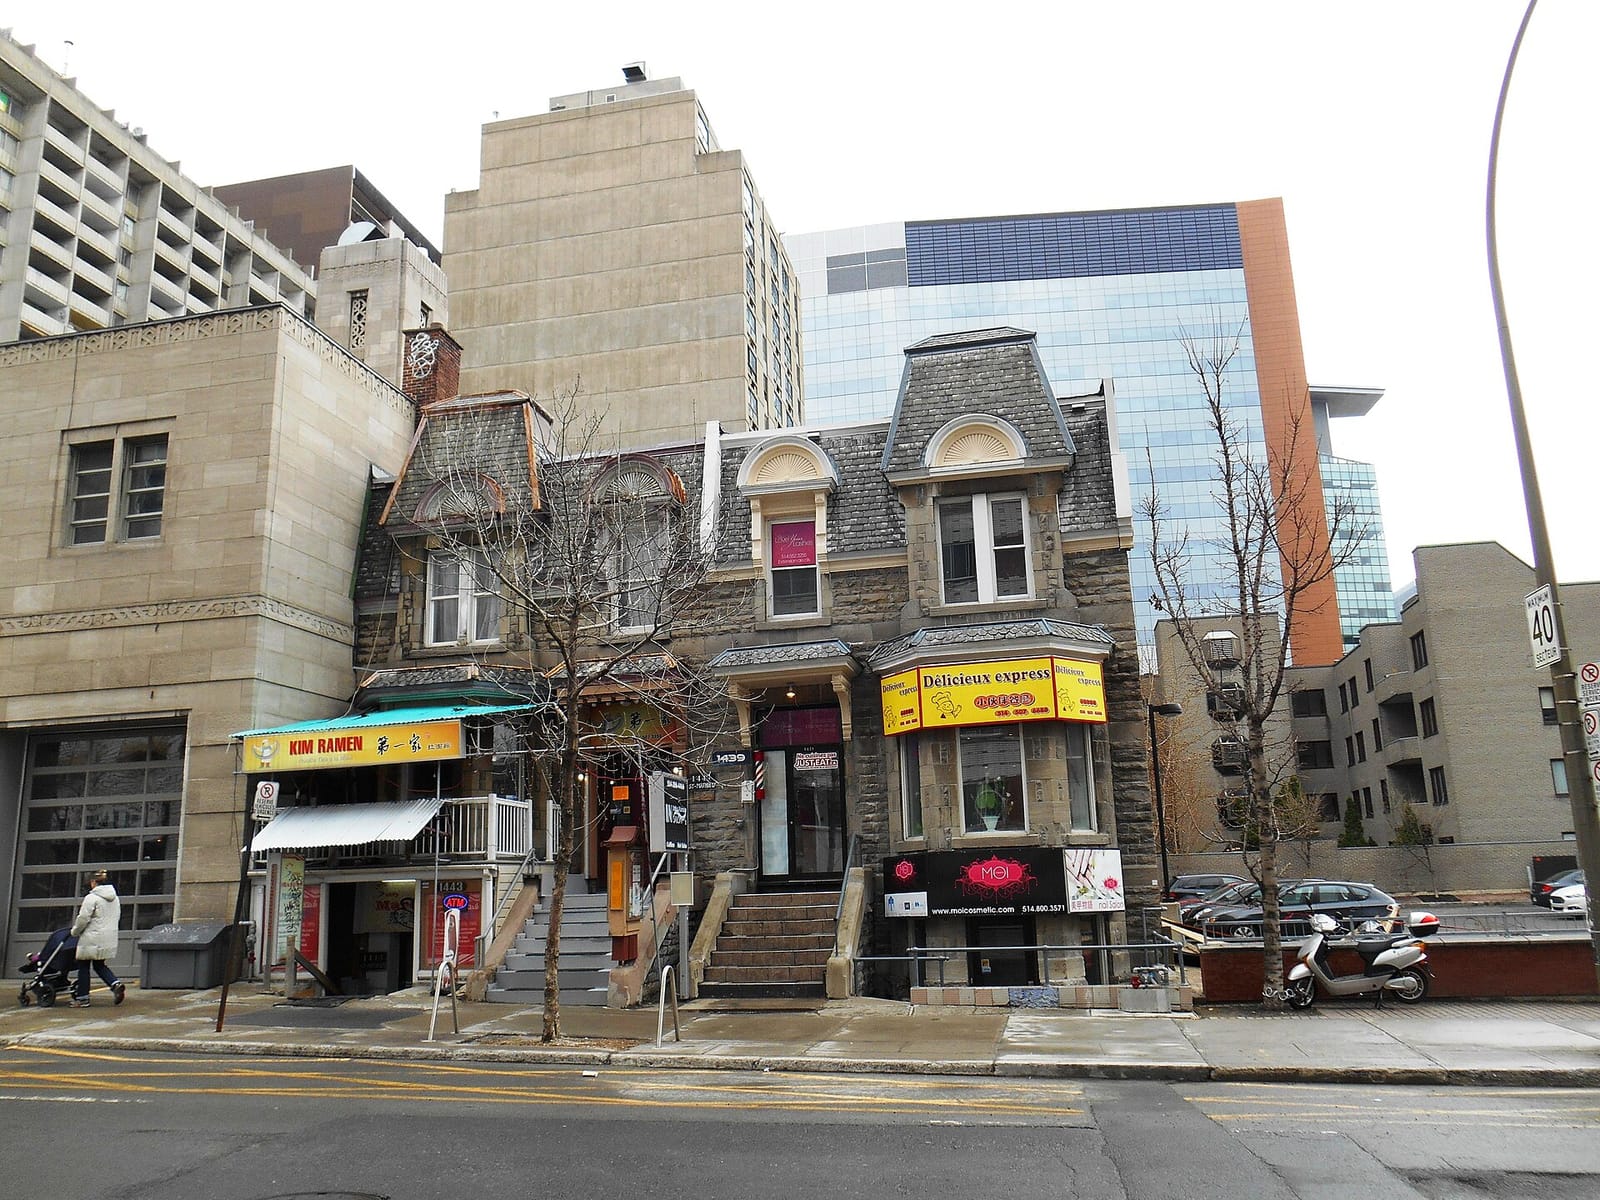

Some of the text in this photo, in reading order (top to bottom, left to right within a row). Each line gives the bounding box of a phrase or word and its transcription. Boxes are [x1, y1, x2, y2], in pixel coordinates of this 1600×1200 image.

[1527, 591, 1549, 609] MAXIMUM
[1533, 605, 1554, 646] 40
[1536, 646, 1557, 664] SECTEUR
[995, 669, 1050, 684] express
[289, 736, 363, 755] KIM RAMEN
[377, 733, 422, 756] 第一家
[716, 753, 746, 763] 1439
[982, 865, 1009, 880] MOI
[439, 882, 464, 892] 1443
[446, 898, 465, 908] ATM
[932, 906, 1015, 915] www.moicosmetic.com
